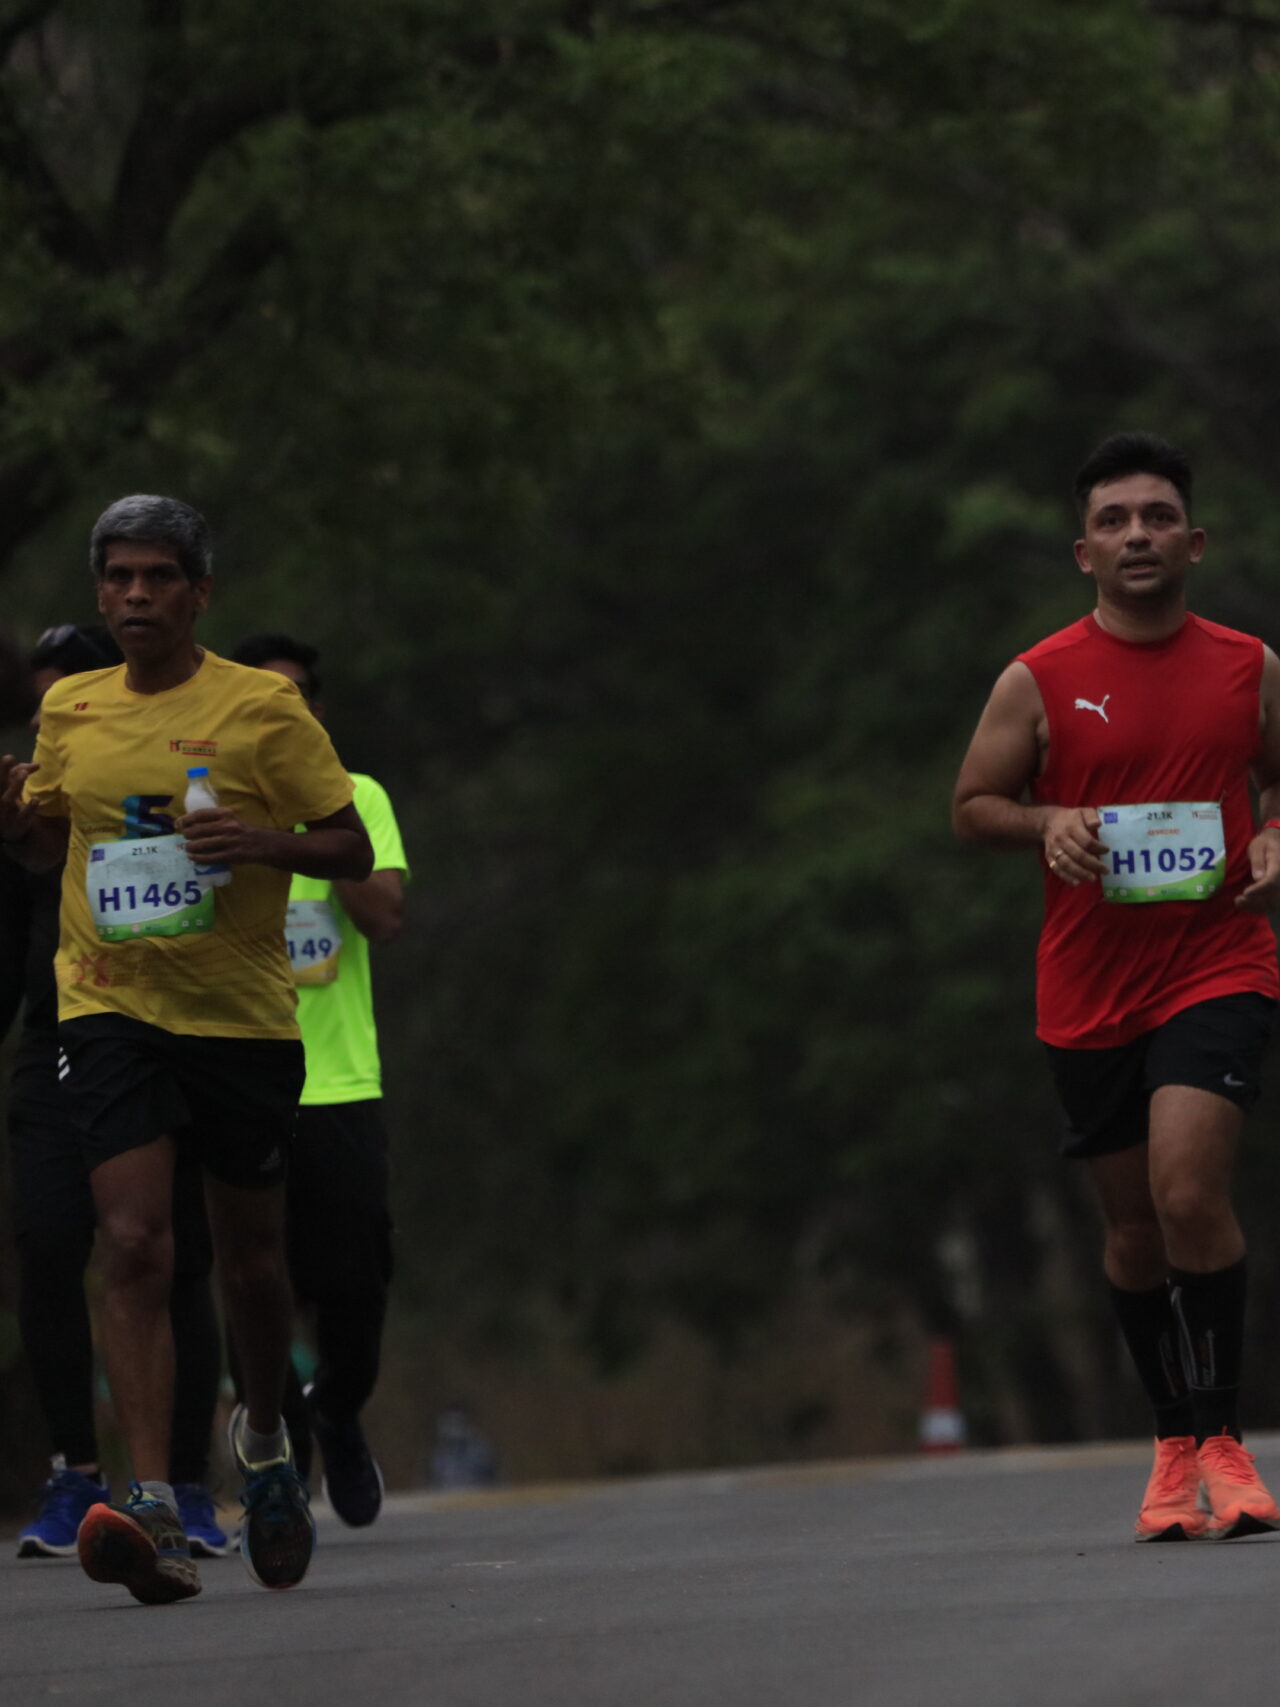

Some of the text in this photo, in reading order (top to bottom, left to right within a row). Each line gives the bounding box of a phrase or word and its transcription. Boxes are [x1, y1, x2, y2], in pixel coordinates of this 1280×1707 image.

[1147, 811, 1173, 820] 21.1K
[132, 846, 158, 856] 21.1K
[1112, 847, 1216, 875] H1052
[99, 880, 202, 913] H1465
